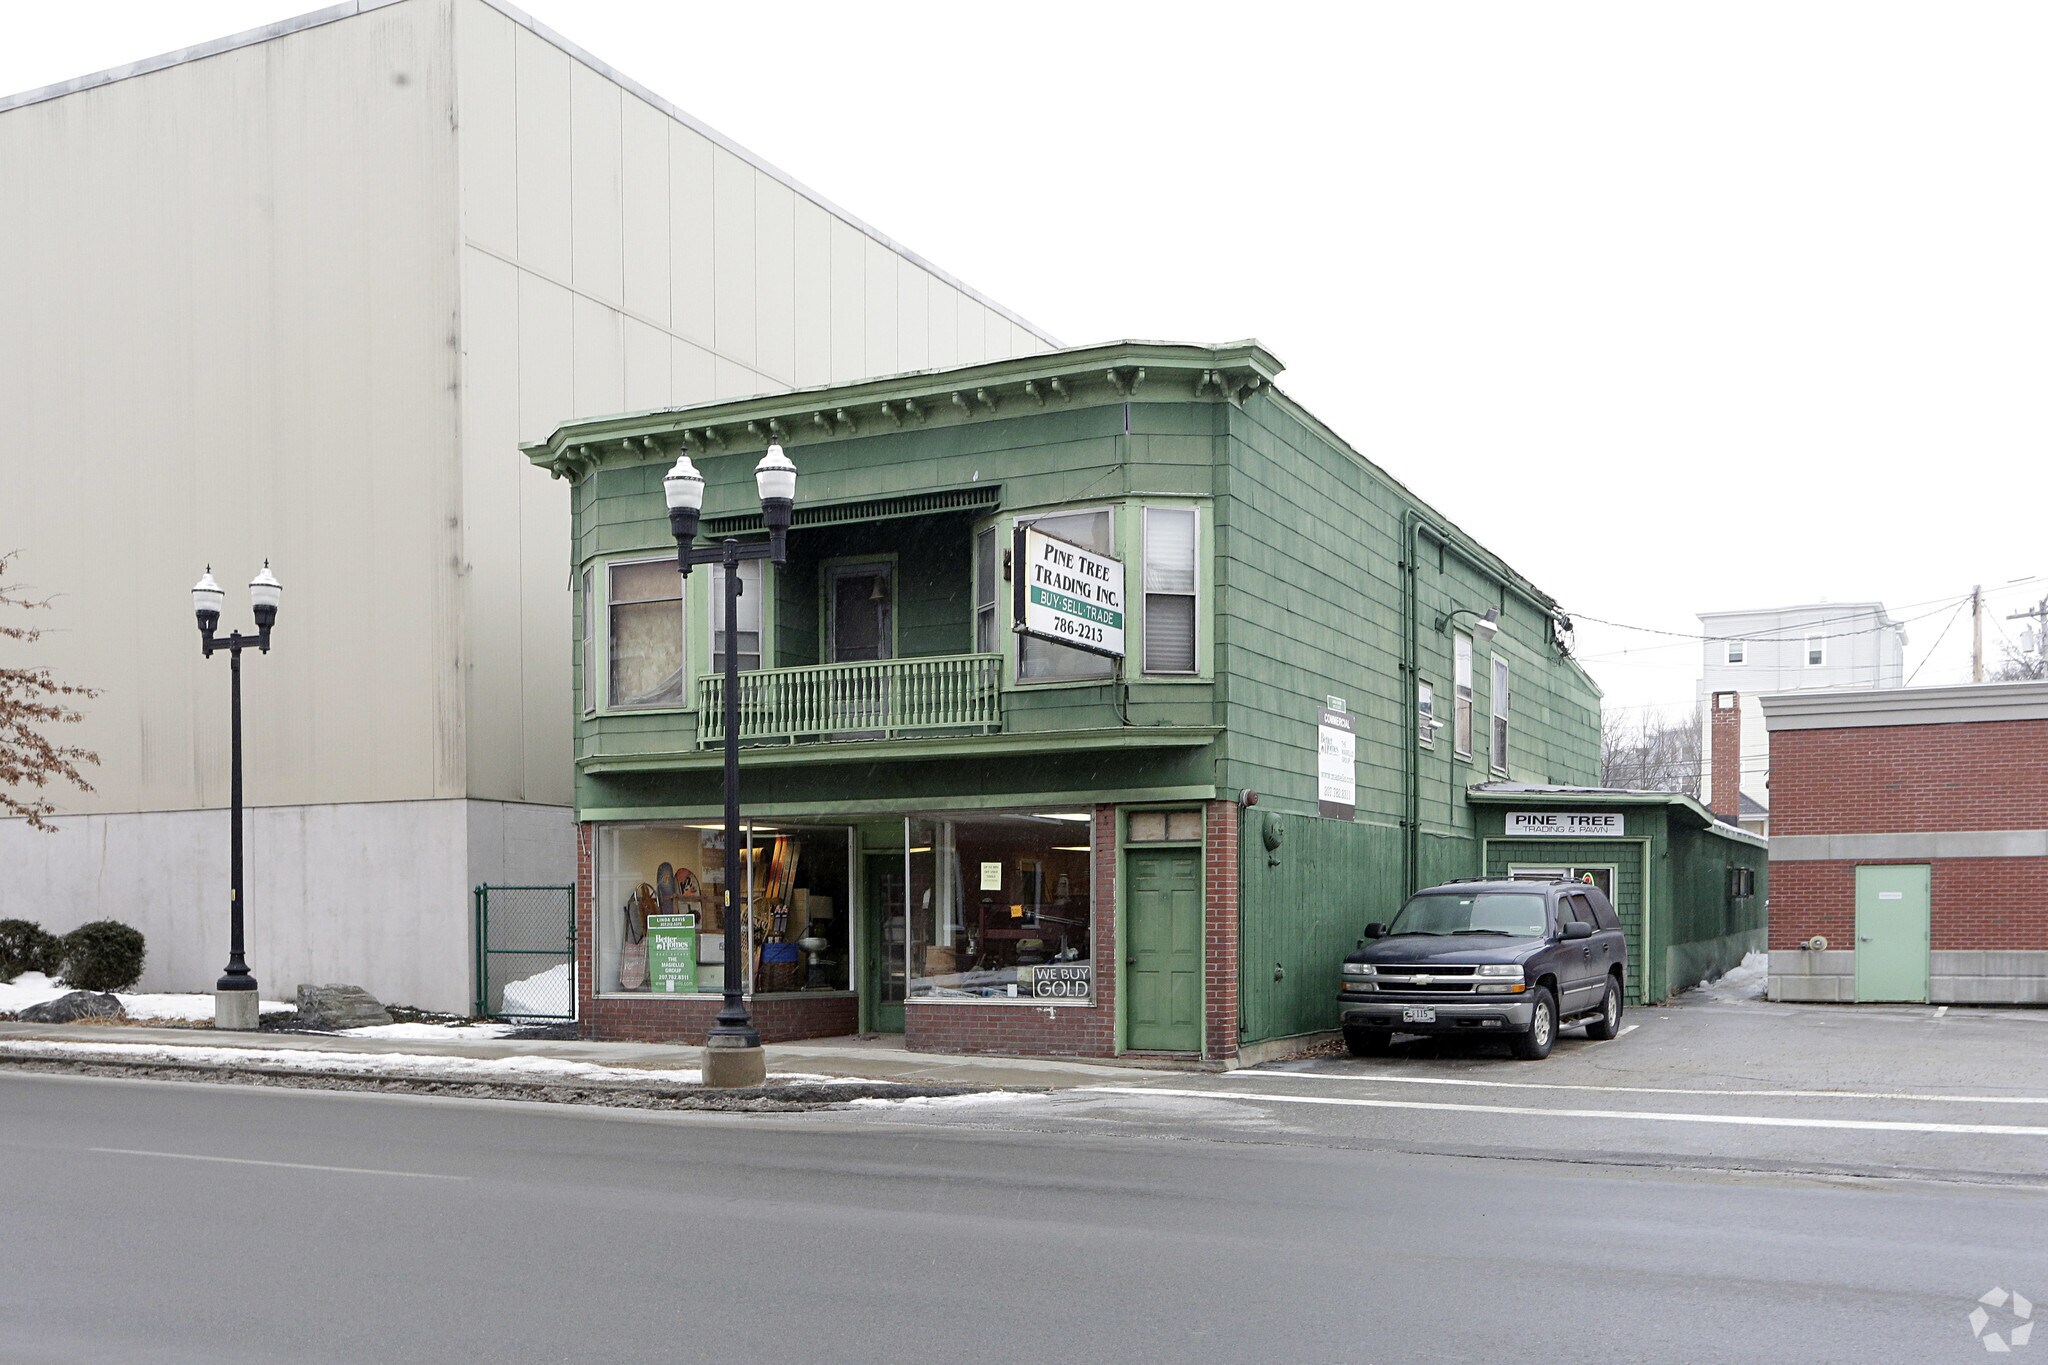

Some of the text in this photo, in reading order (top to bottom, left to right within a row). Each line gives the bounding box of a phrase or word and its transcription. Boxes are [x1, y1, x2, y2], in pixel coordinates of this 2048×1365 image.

[1044, 543, 1110, 582] PINE TREE
[1035, 564, 1119, 607] TRADING INC.
[1054, 616, 1103, 643] 786-2213
[1324, 713, 1351, 729] COMMERCIAL
[1515, 815, 1615, 826] PINE TREE
[655, 934, 678, 943] Better
[663, 941, 689, 950] Homes
[1036, 968, 1089, 980] WE BUY
[1037, 980, 1088, 997] GOLD
